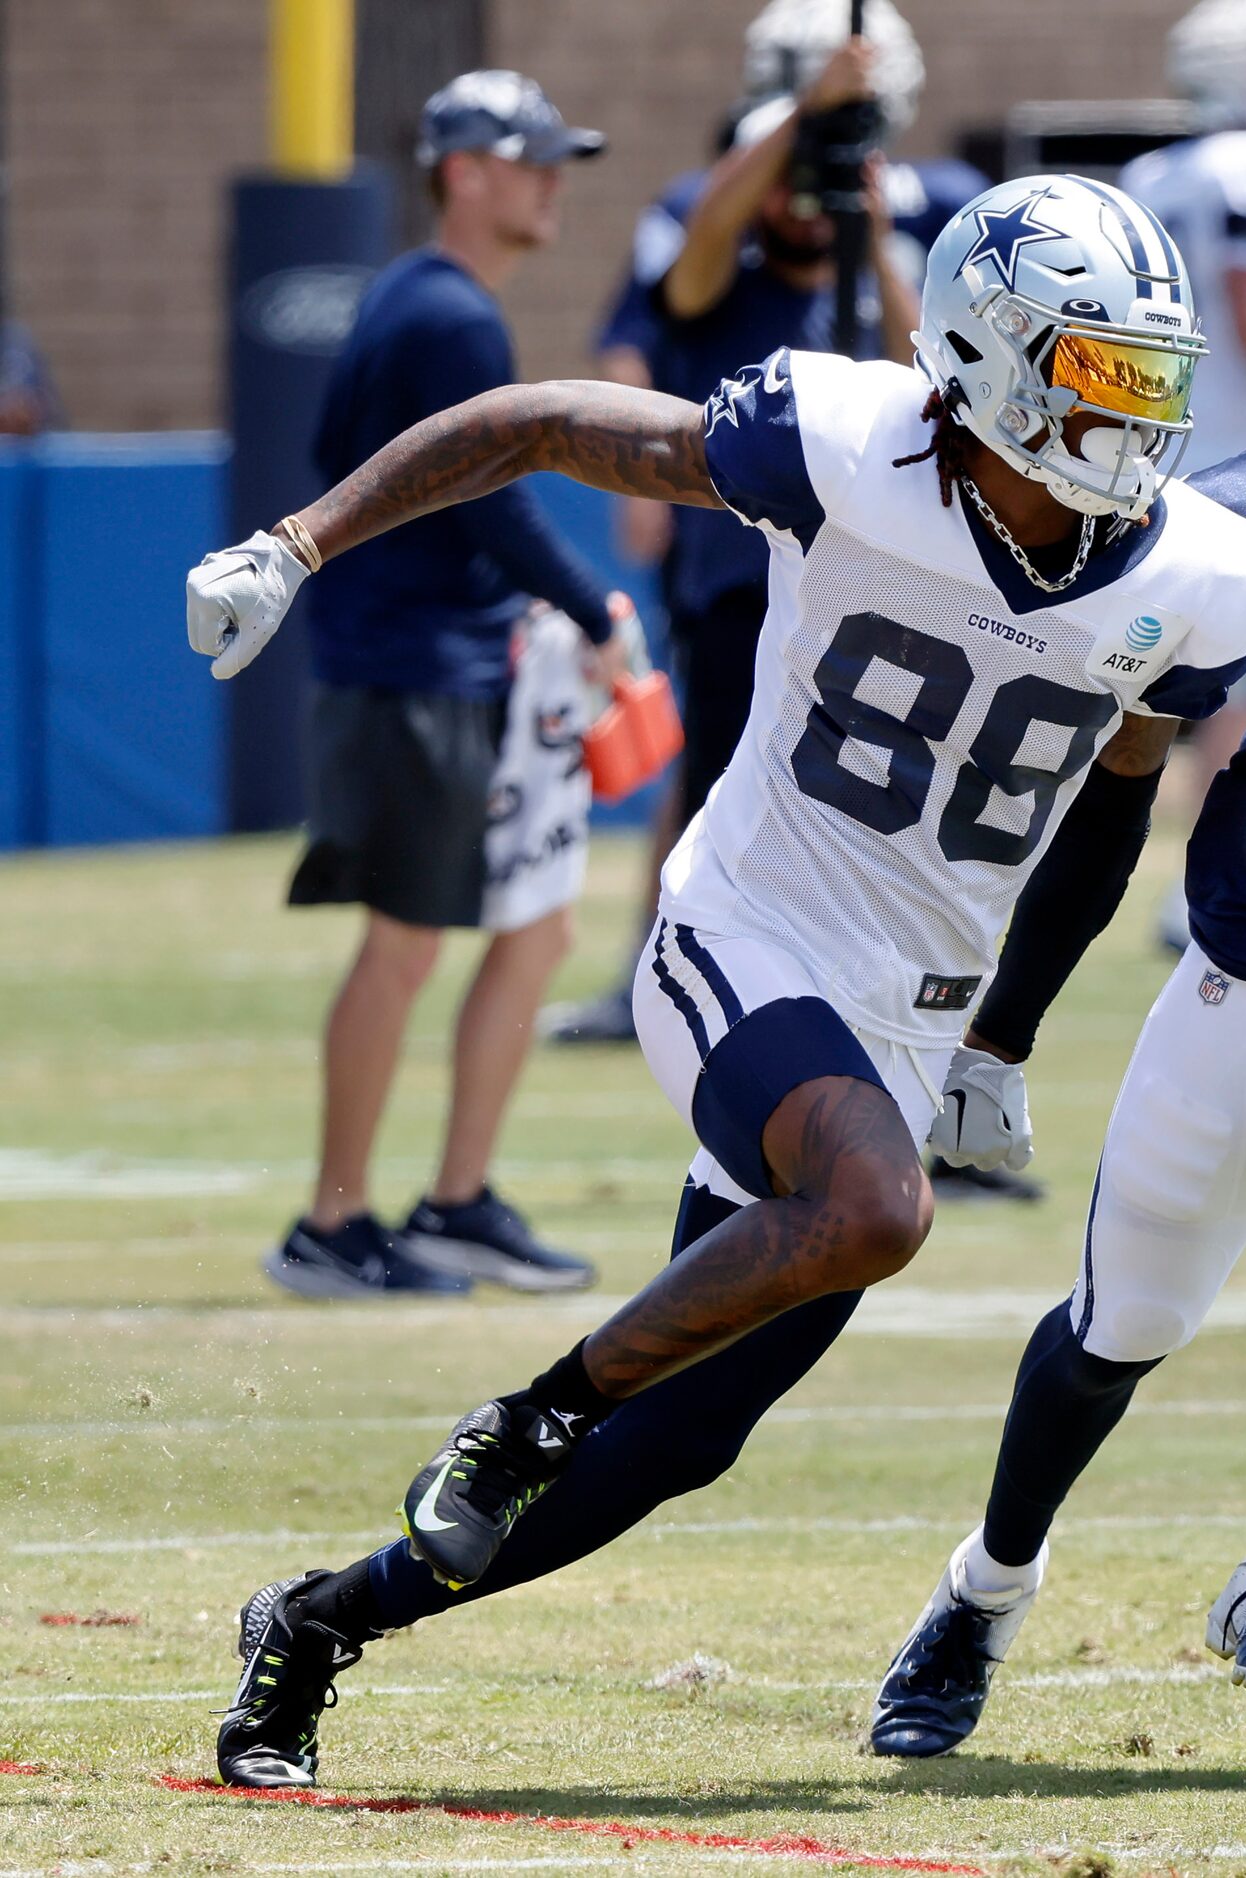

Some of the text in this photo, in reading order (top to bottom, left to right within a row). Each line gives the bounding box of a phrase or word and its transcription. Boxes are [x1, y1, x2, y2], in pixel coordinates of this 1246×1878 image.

[1144, 312, 1182, 327] COWBOYS
[968, 613, 1048, 654] COWBOYS
[1102, 653, 1147, 674] AT&T
[790, 611, 1119, 866] 88
[1201, 981, 1223, 1002] NFL
